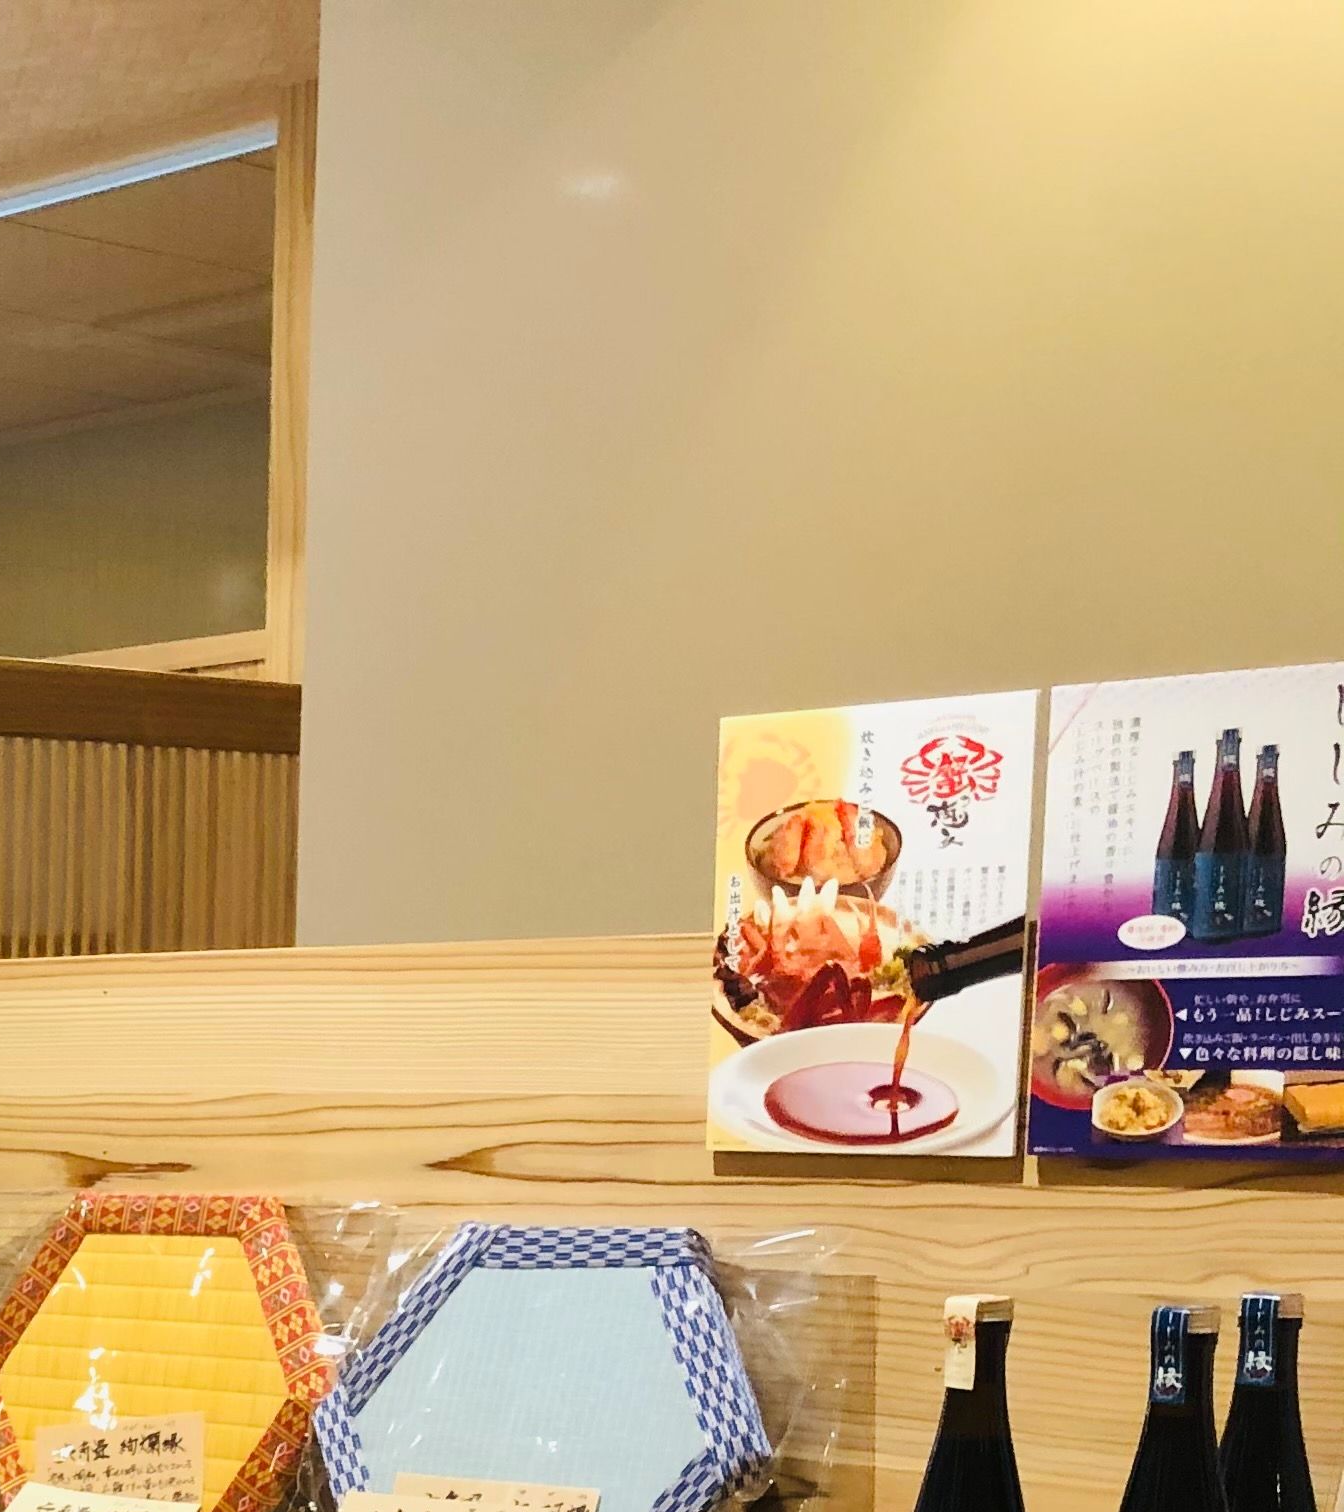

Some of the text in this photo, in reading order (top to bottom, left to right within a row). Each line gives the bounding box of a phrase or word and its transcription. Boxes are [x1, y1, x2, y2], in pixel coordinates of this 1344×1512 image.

[1196, 1046, 1344, 1062] 色々な料理の隠し味
